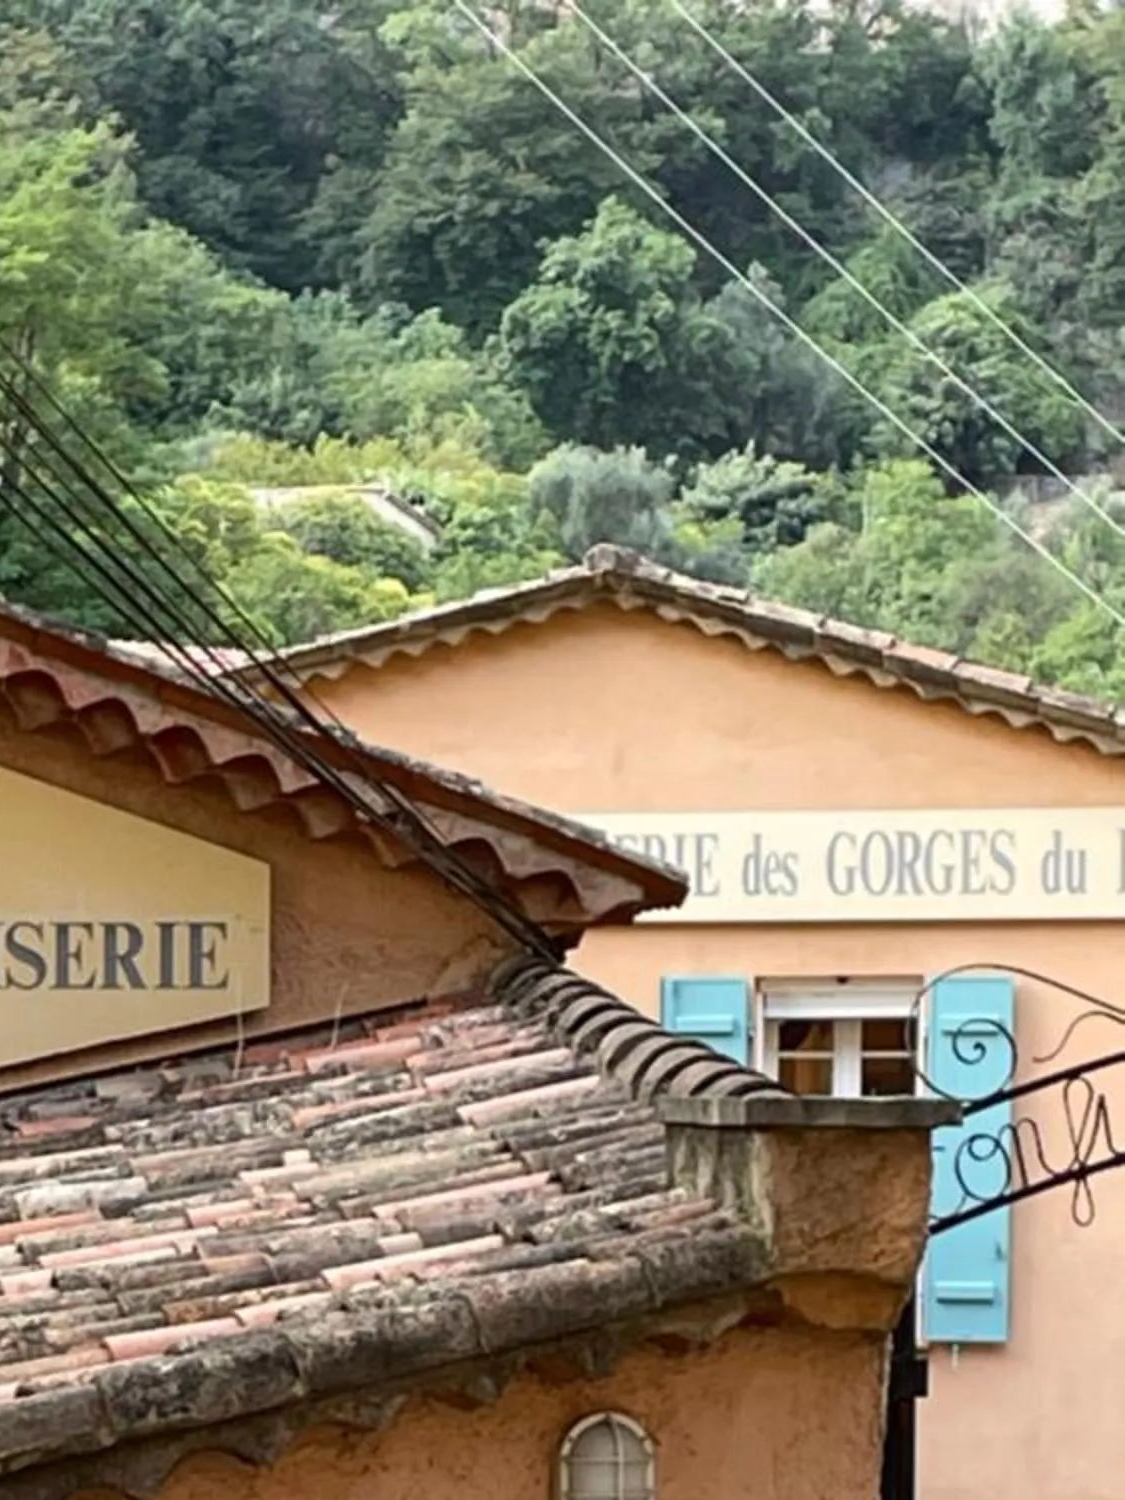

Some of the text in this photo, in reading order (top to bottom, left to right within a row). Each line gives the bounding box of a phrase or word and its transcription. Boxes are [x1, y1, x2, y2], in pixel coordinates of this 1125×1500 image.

[742, 833, 799, 898] des
[826, 830, 1017, 897] GORGES
[1041, 829, 1088, 896] du
